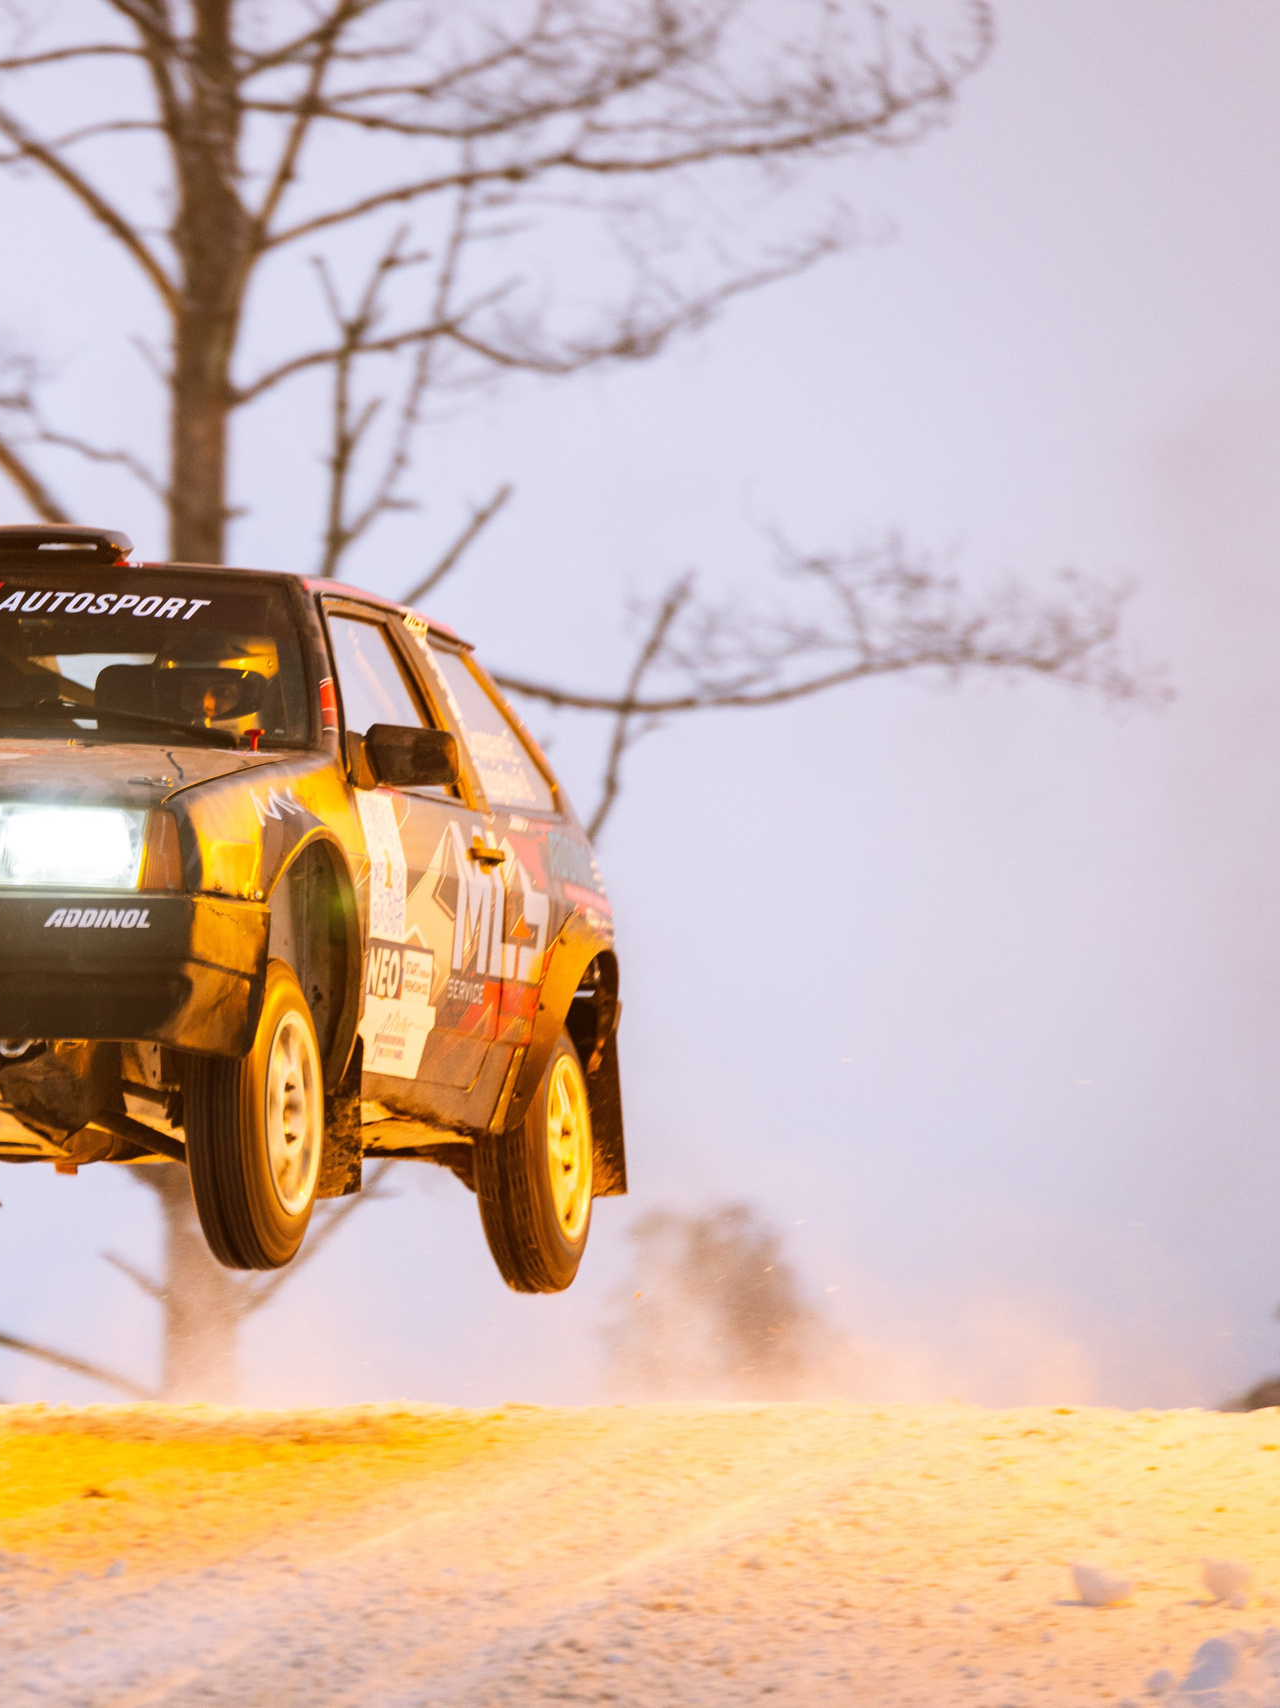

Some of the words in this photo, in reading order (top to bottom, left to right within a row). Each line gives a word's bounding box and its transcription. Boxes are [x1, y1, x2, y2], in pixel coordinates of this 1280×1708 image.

[43, 908, 151, 929] ADDINOL
[365, 946, 401, 998] NEO
[447, 978, 486, 1005] SERVICE
